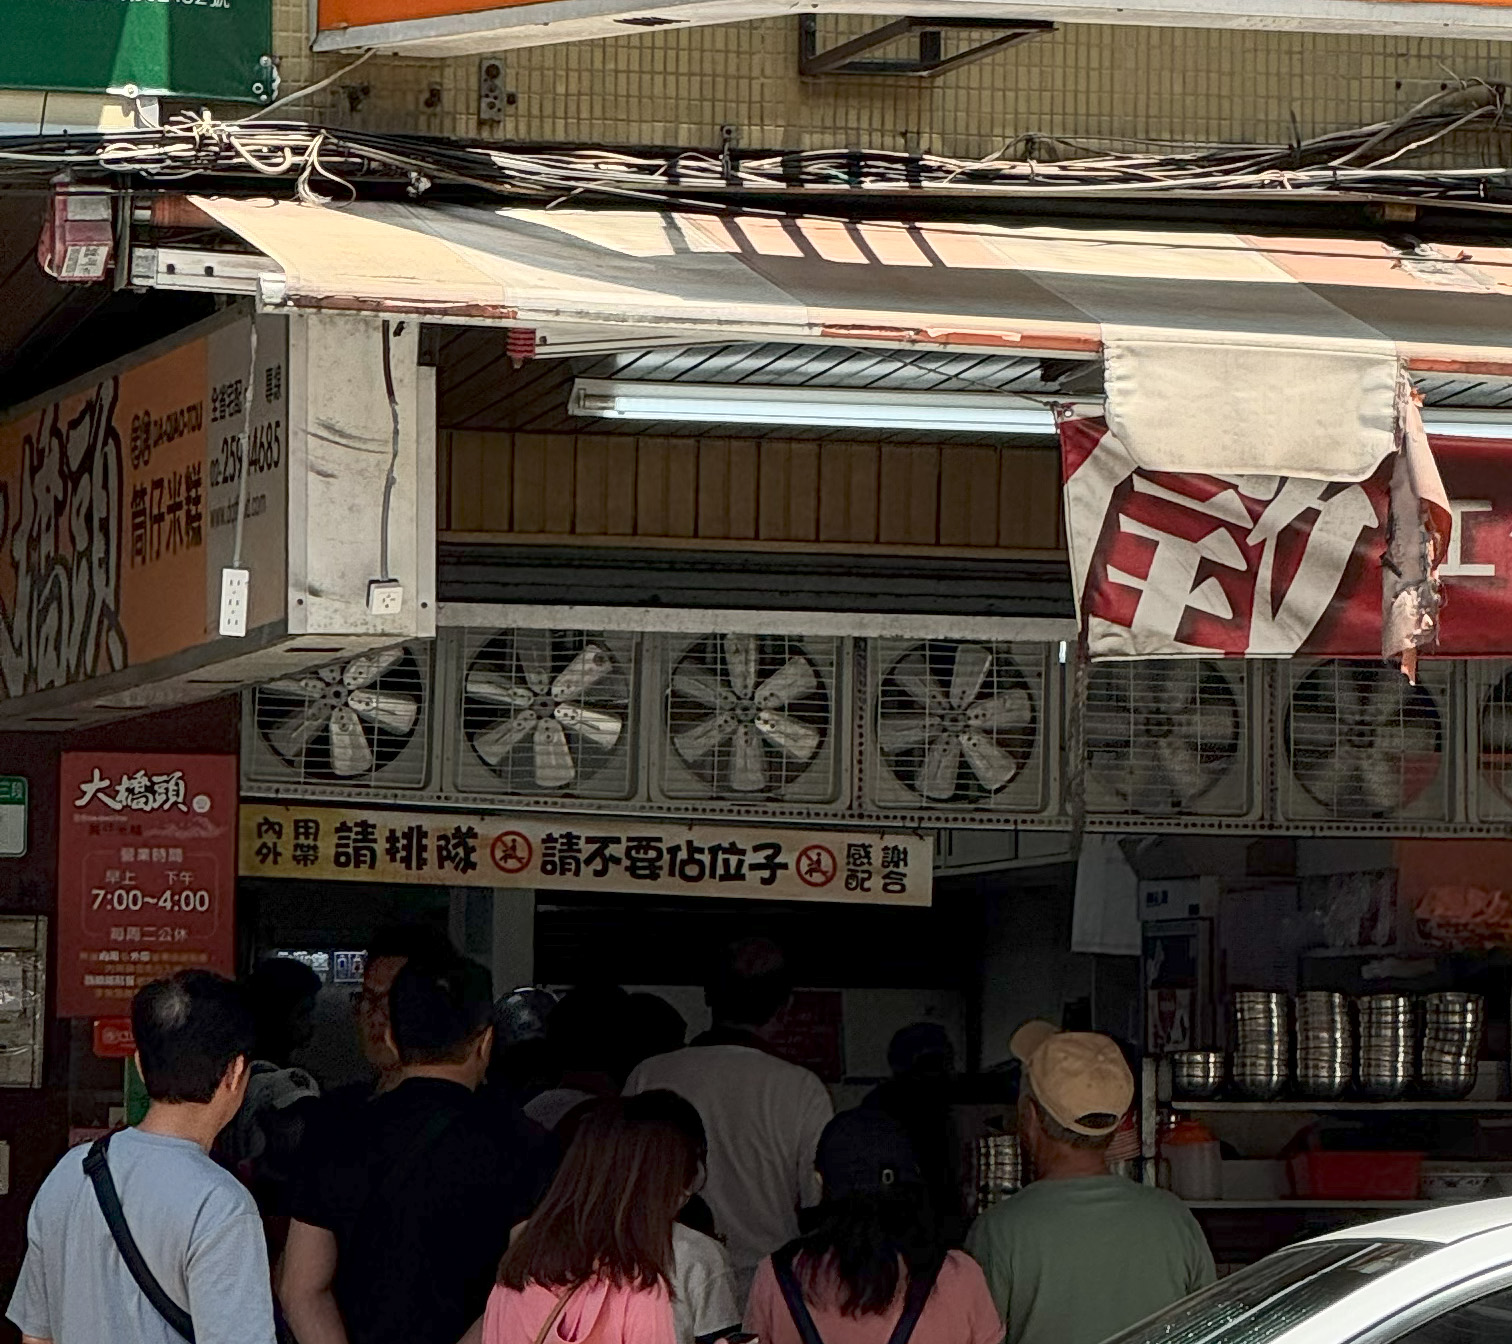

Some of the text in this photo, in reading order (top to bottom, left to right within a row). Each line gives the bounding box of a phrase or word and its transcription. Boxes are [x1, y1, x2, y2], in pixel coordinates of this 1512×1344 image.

[209, 420, 282, 488] 02-2594685
[130, 460, 204, 570] 筒仔米糕
[74, 767, 190, 814] 大橋頭
[255, 841, 320, 868] 外帶
[333, 818, 789, 887] 請排隊 請不要佔位子
[846, 842, 909, 869] 感謝
[164, 869, 194, 886] 下午
[844, 867, 908, 895] 配合
[91, 887, 210, 912] 7:00~4:00
